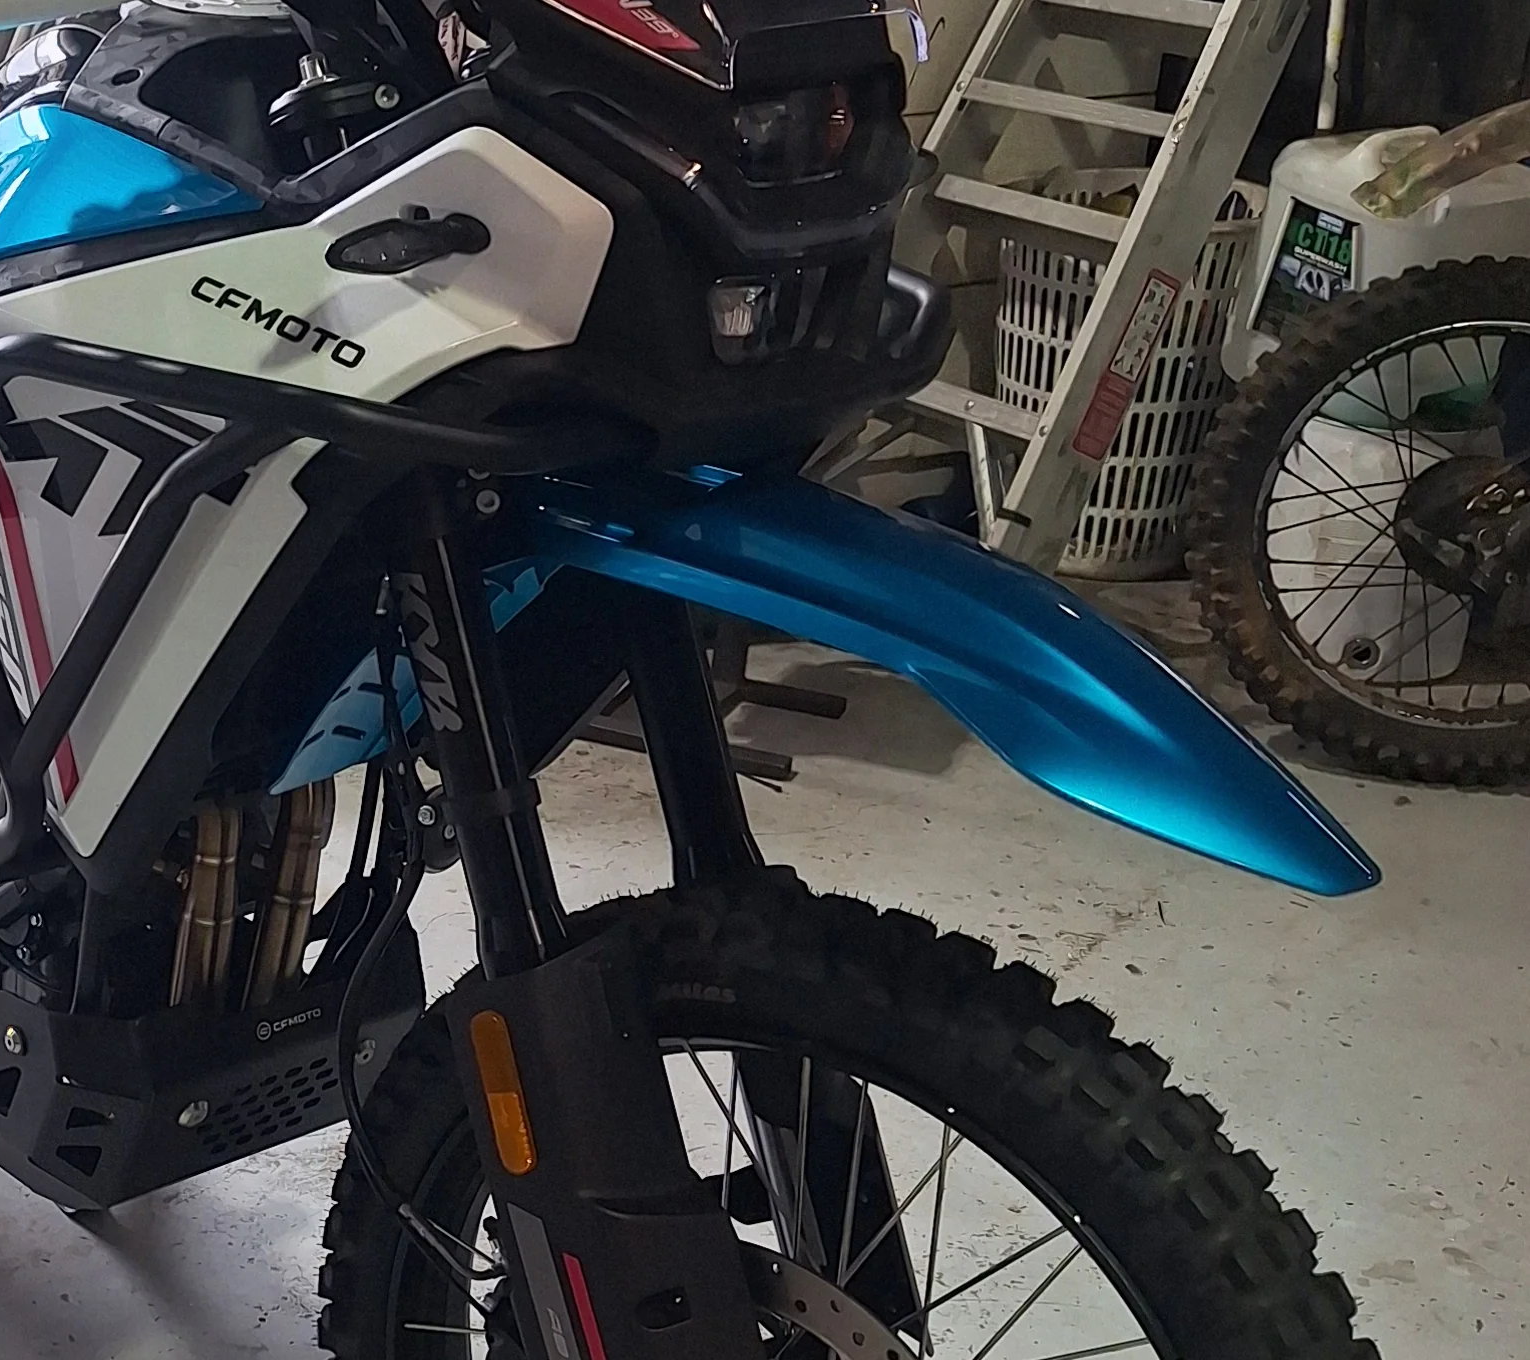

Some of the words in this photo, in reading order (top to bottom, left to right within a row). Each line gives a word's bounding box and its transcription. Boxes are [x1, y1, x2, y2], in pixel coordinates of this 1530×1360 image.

[1293, 245, 1348, 273] SUPERWASH
[191, 276, 366, 369] CFMOTO
[389, 572, 463, 732] KYB
[273, 1008, 321, 1032] CFMOTO
